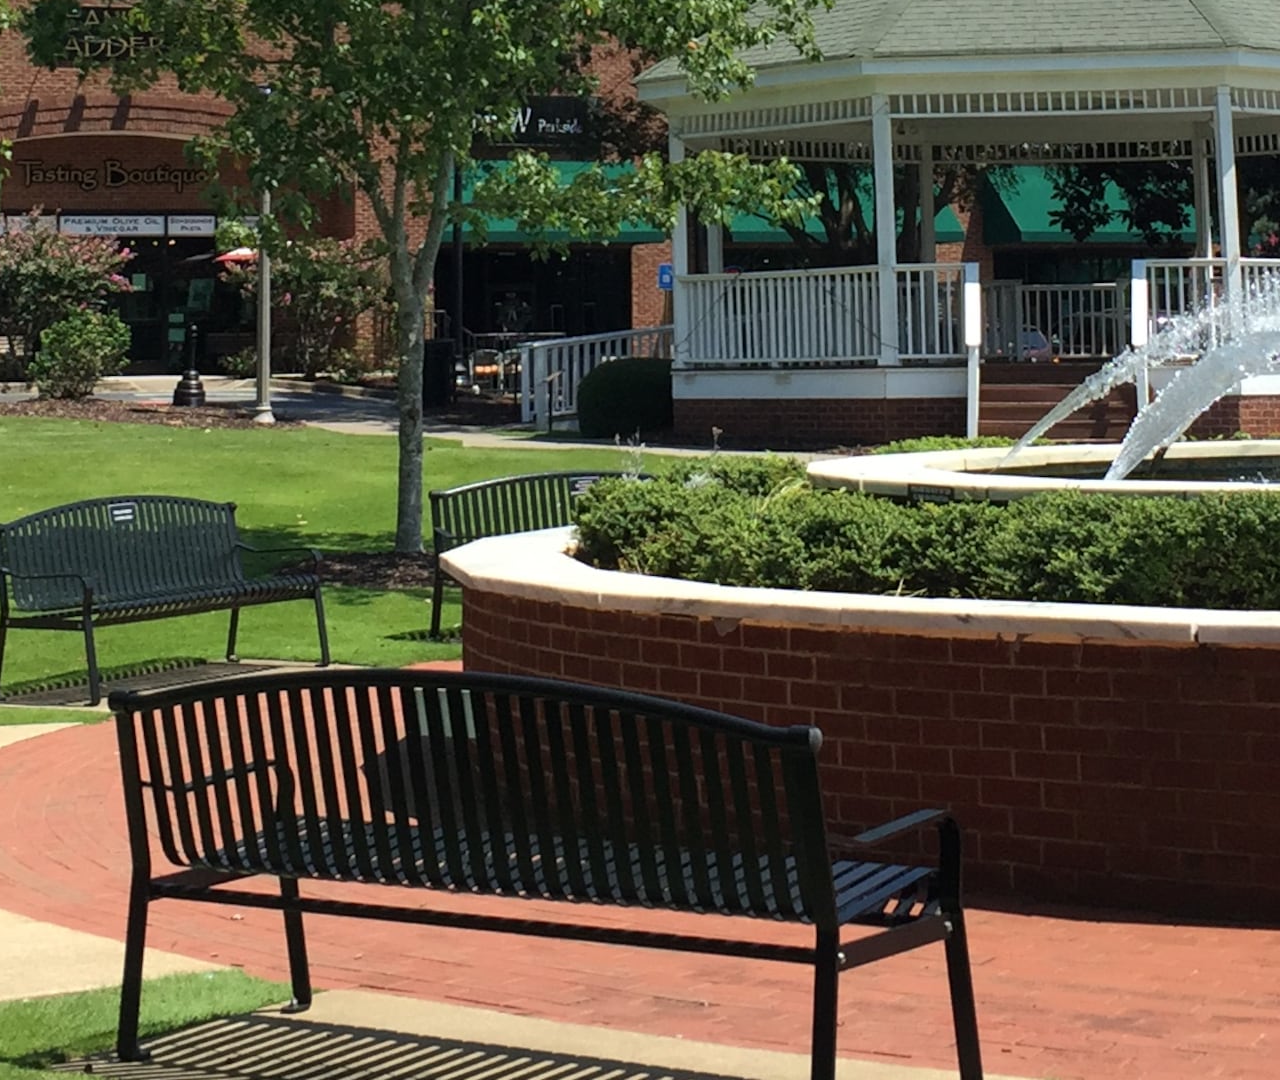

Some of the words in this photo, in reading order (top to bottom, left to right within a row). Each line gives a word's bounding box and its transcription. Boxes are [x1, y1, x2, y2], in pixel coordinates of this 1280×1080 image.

[54, 35, 164, 58] ADDER
[17, 160, 97, 191] Tasting
[112, 217, 139, 225] OLIVE
